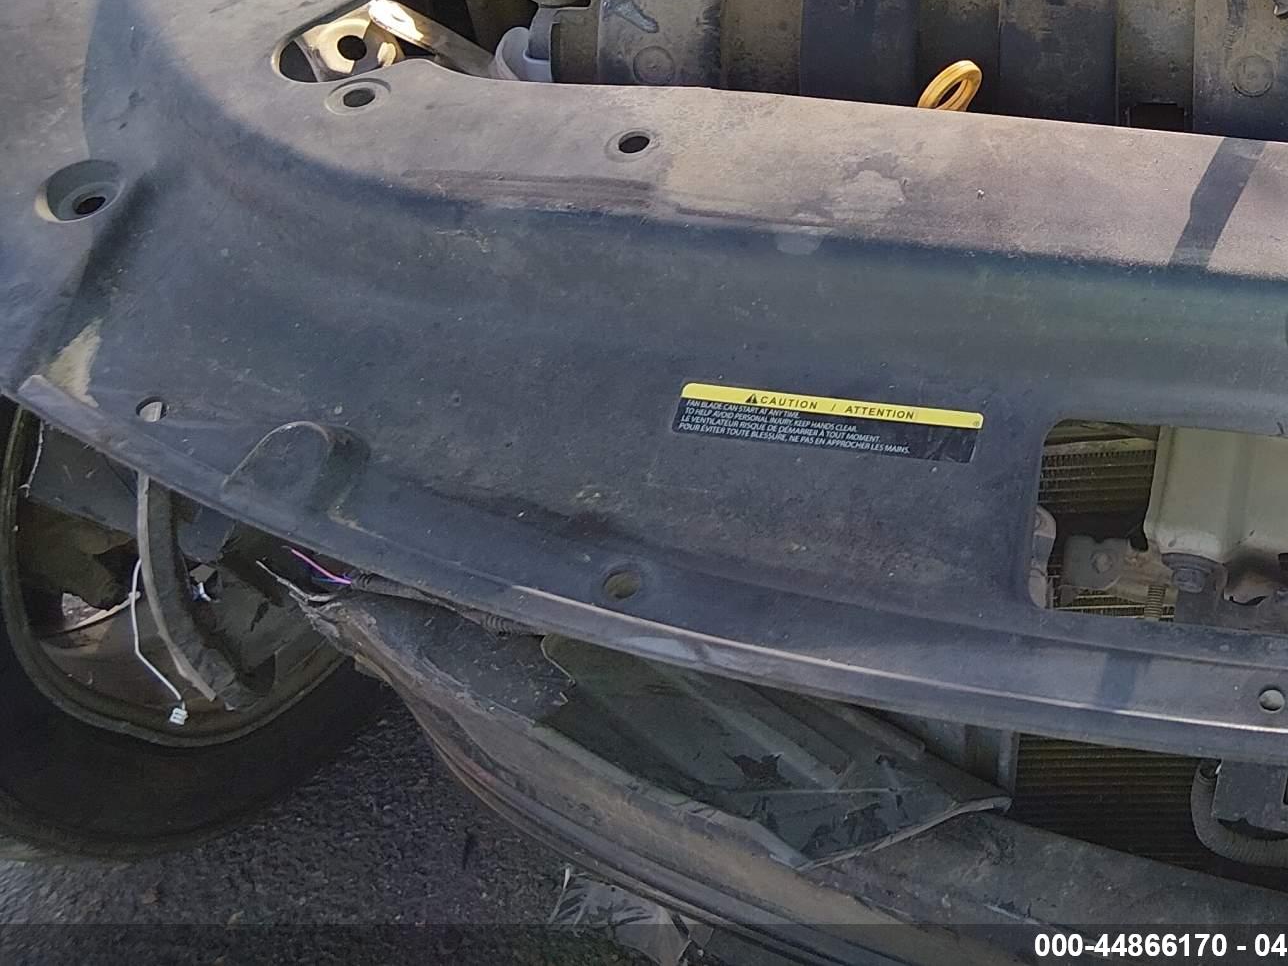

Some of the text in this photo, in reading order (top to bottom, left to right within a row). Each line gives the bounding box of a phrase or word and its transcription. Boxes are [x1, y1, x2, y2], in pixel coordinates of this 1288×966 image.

[685, 407, 695, 415] TO
[695, 408, 712, 417] HELP
[712, 410, 734, 420] AVOID
[734, 413, 768, 423] PERSONAL
[794, 418, 811, 427] KEEP
[811, 421, 836, 430] HANDS
[686, 399, 700, 407] FAN
[701, 401, 721, 409] BLADE
[722, 403, 738, 411] CAN
[738, 405, 759, 414] START
[759, 407, 769, 415] AT
[760, 396, 818, 409] CAUTION
[845, 405, 915, 420] ATTENTION
[679, 423, 700, 431] POUR
[700, 423, 726, 434] ÉVITER
[726, 427, 751, 437] TOUTE
[789, 435, 800, 443] NE
[800, 436, 814, 444] PAS
[815, 437, 826, 445] EN
[826, 439, 870, 450] APPROCHER
[870, 443, 884, 451] LES
[690, 416, 738, 428] VENTILATEUR
[740, 421, 767, 431] RISQUE
[767, 424, 777, 432] DE
[779, 424, 819, 436] DÉMARRER
[826, 430, 845, 439] TOUT
